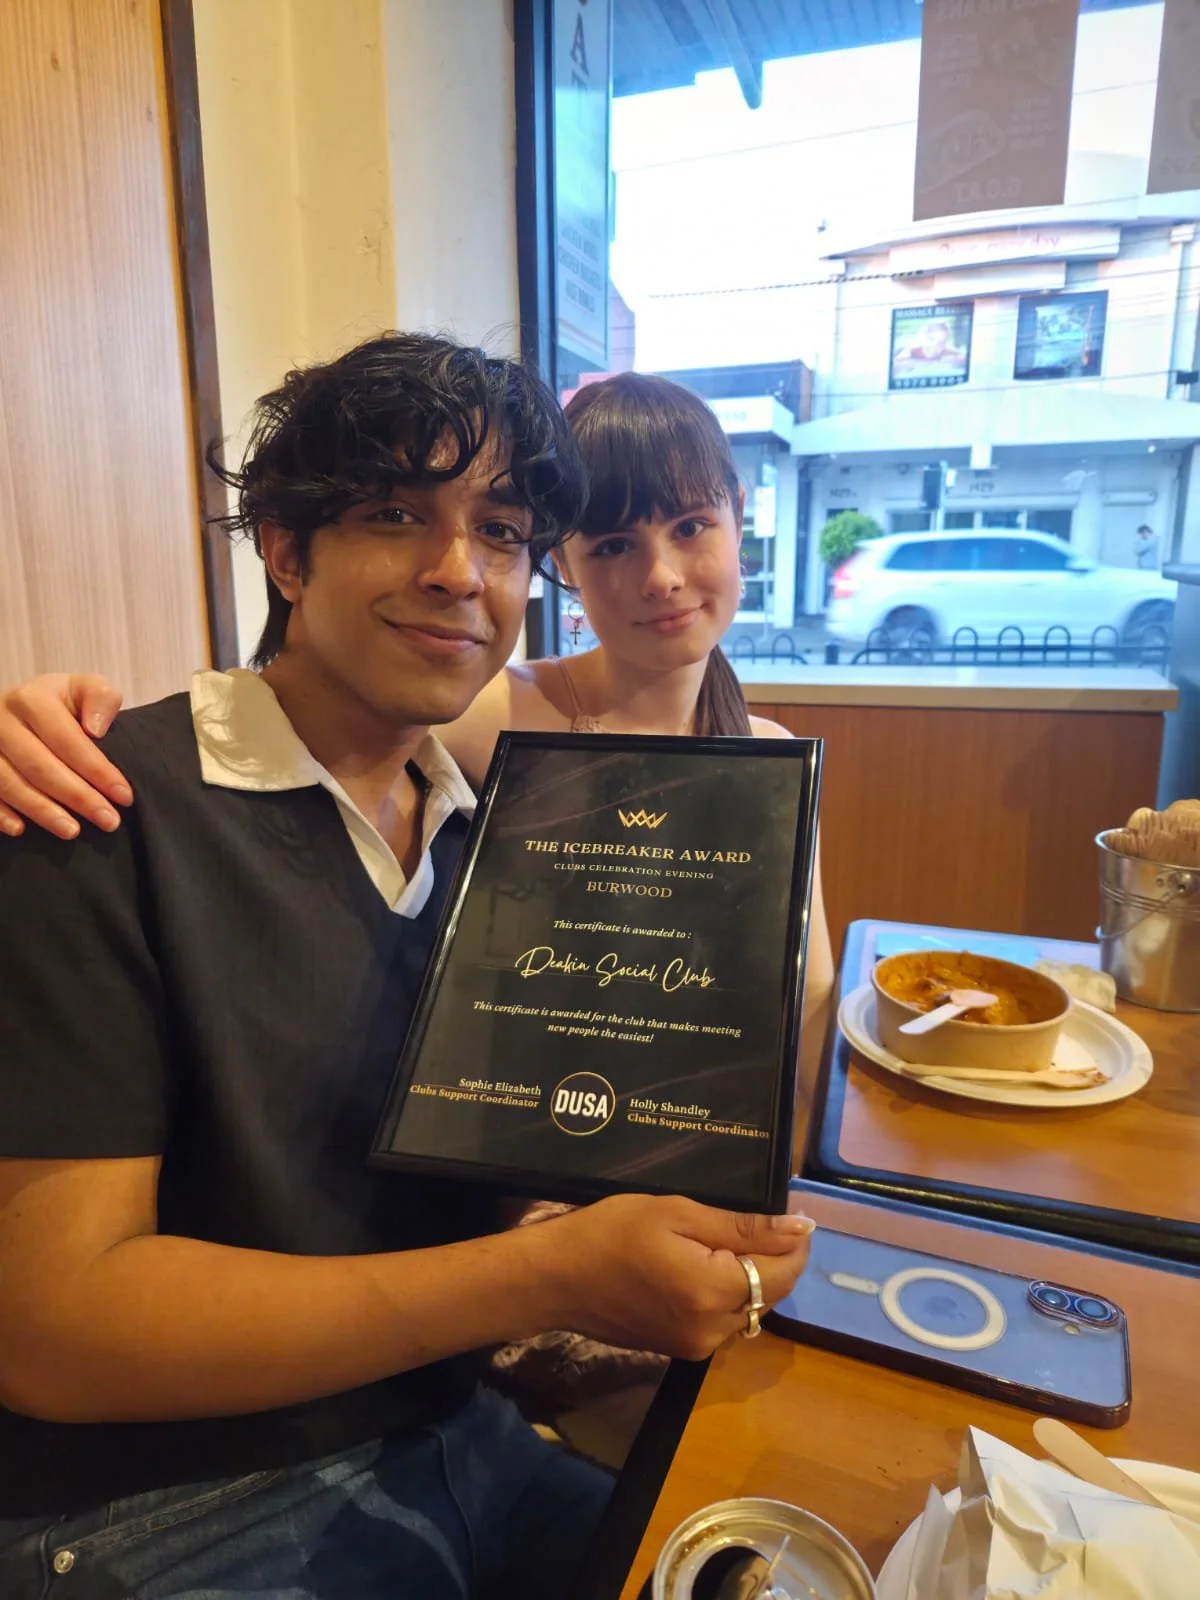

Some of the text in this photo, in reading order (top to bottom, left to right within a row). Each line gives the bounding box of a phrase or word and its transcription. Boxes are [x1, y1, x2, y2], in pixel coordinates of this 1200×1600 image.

[525, 840, 751, 864] THE ICEBREAKER AWARD
[554, 863, 714, 880] CLUBS CELEBRATION EVENING
[587, 881, 672, 898] BURWOOD
[553, 920, 572, 930] This
[574, 921, 621, 934] certificate
[622, 923, 631, 934] is
[632, 927, 675, 939] awarded
[676, 929, 686, 939] to
[515, 946, 715, 992] Deakin Social Club
[473, 1001, 742, 1038] This certificate is awarded for the club that makes meeting
[547, 1022, 654, 1044] new people the easiest!
[409, 1084, 539, 1108] Clubs Support Coordinator
[459, 1077, 542, 1095] Sophie Elizabeth
[554, 1088, 608, 1119] DUSA
[630, 1097, 711, 1118] Holly Shandley
[627, 1113, 657, 1125] Clubs
[659, 1117, 701, 1131] Support
